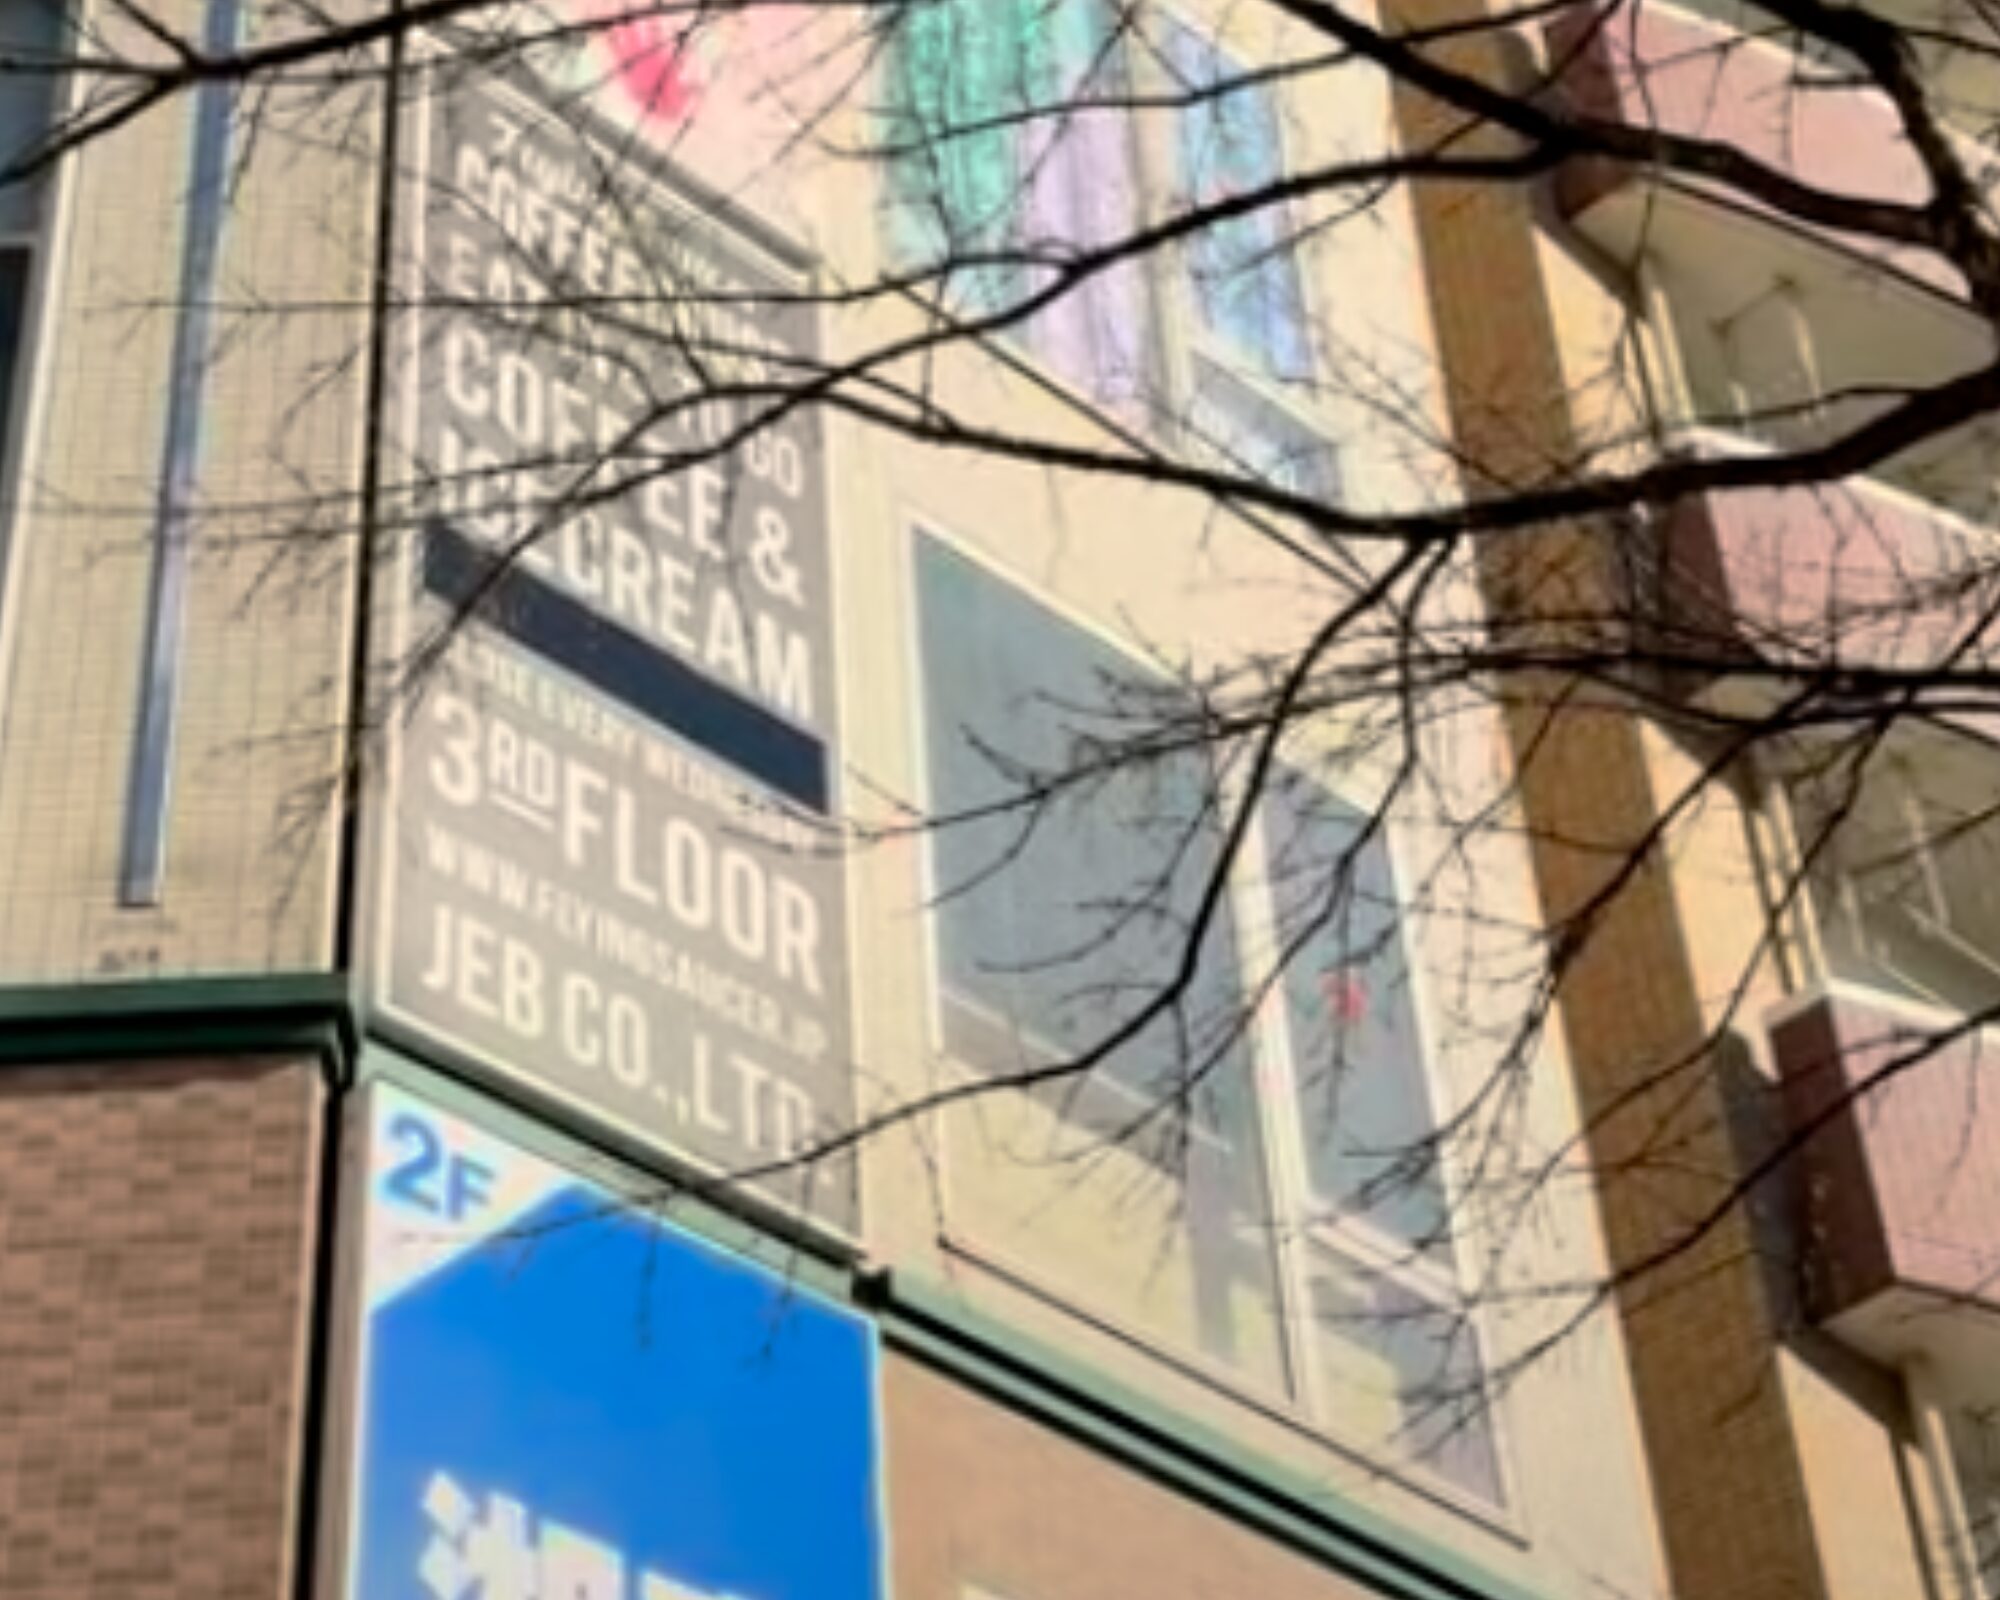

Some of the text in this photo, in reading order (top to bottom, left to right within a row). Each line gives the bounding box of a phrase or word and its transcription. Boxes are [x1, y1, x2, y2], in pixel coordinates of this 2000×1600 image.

[444, 325, 725, 562] COFFEE
[749, 507, 802, 606] &
[745, 428, 803, 499] GO
[429, 692, 824, 997] 3RD FLOOR
[420, 902, 543, 1037] JEB
[386, 1113, 495, 1222] 2F
